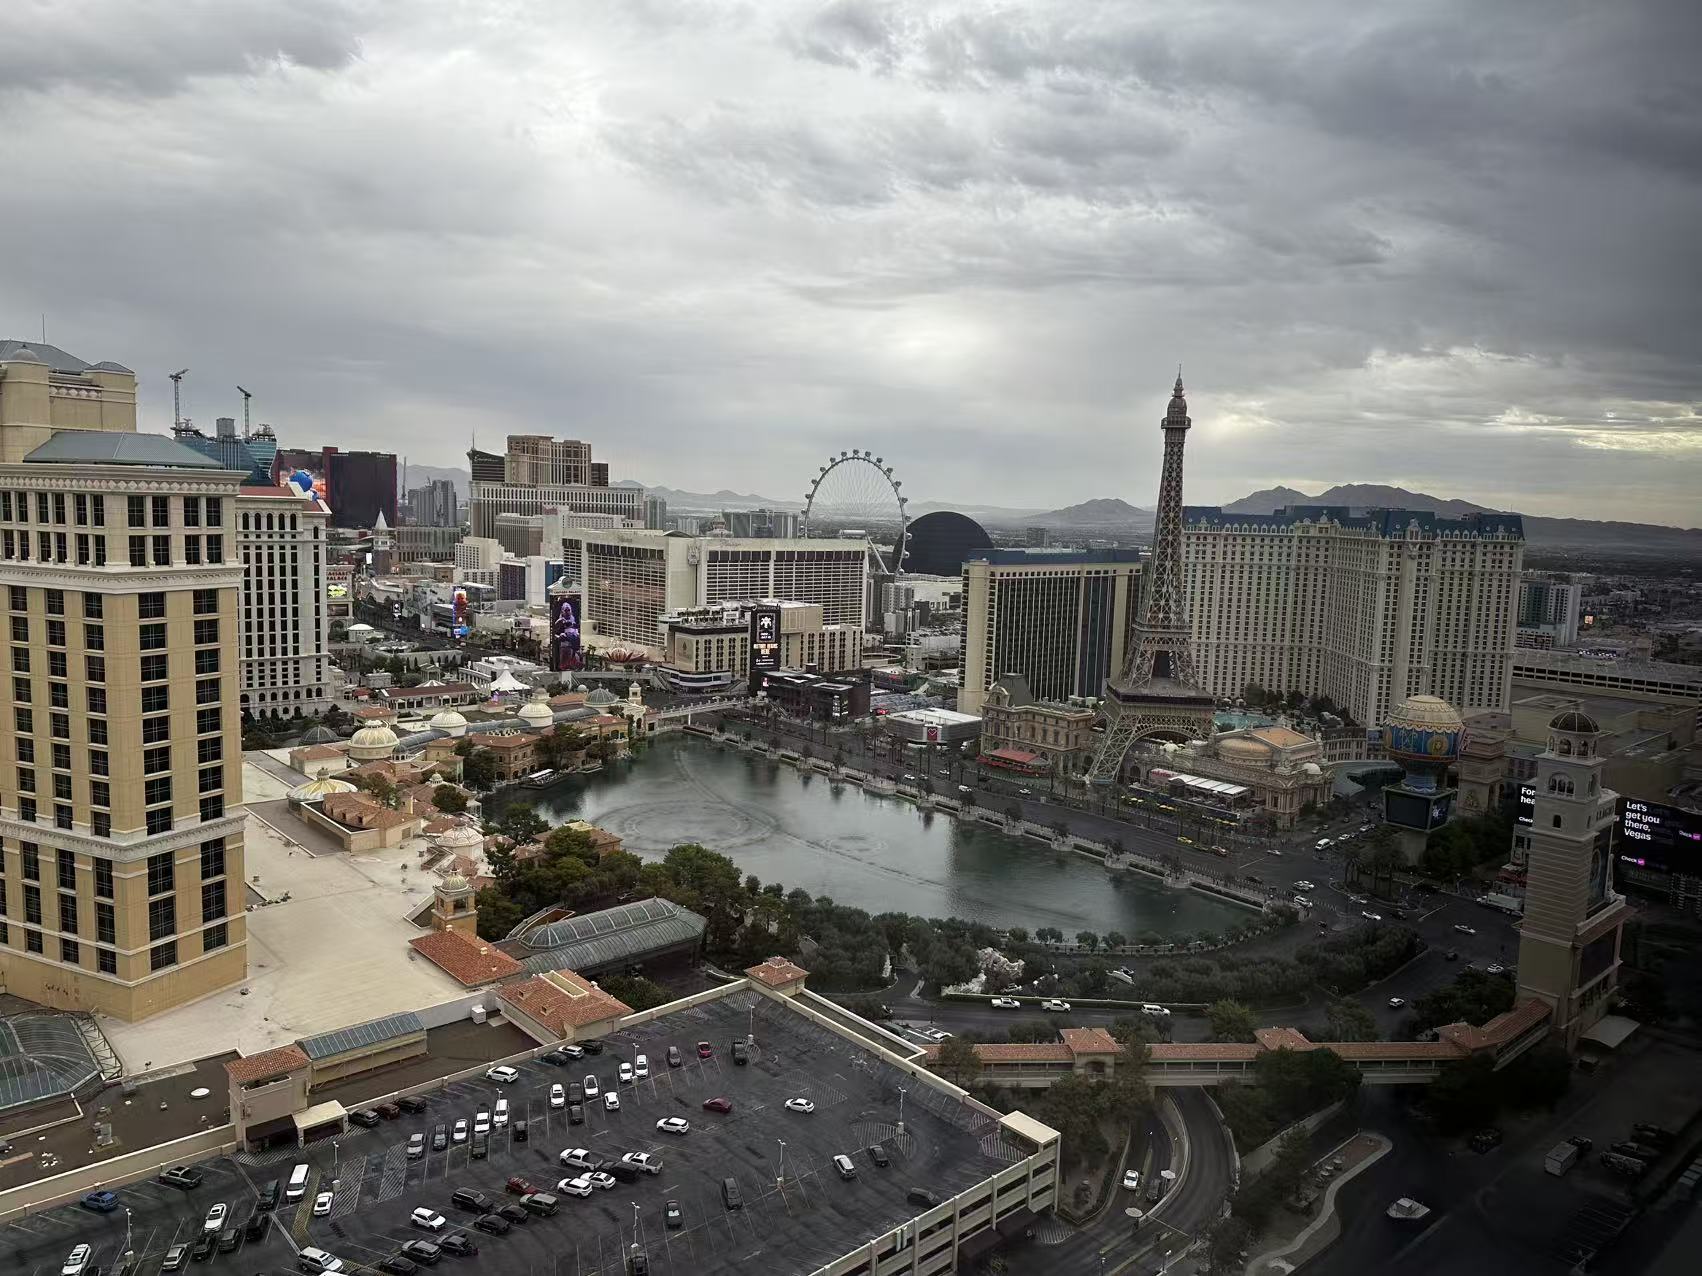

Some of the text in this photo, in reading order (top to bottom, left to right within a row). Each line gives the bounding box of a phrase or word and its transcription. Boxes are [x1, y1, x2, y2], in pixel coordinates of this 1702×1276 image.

[1626, 801, 1648, 812] Let's
[1625, 811, 1641, 820] get
[1641, 814, 1660, 824] you
[1624, 819, 1651, 832] there,
[1624, 827, 1652, 841] Vegas
